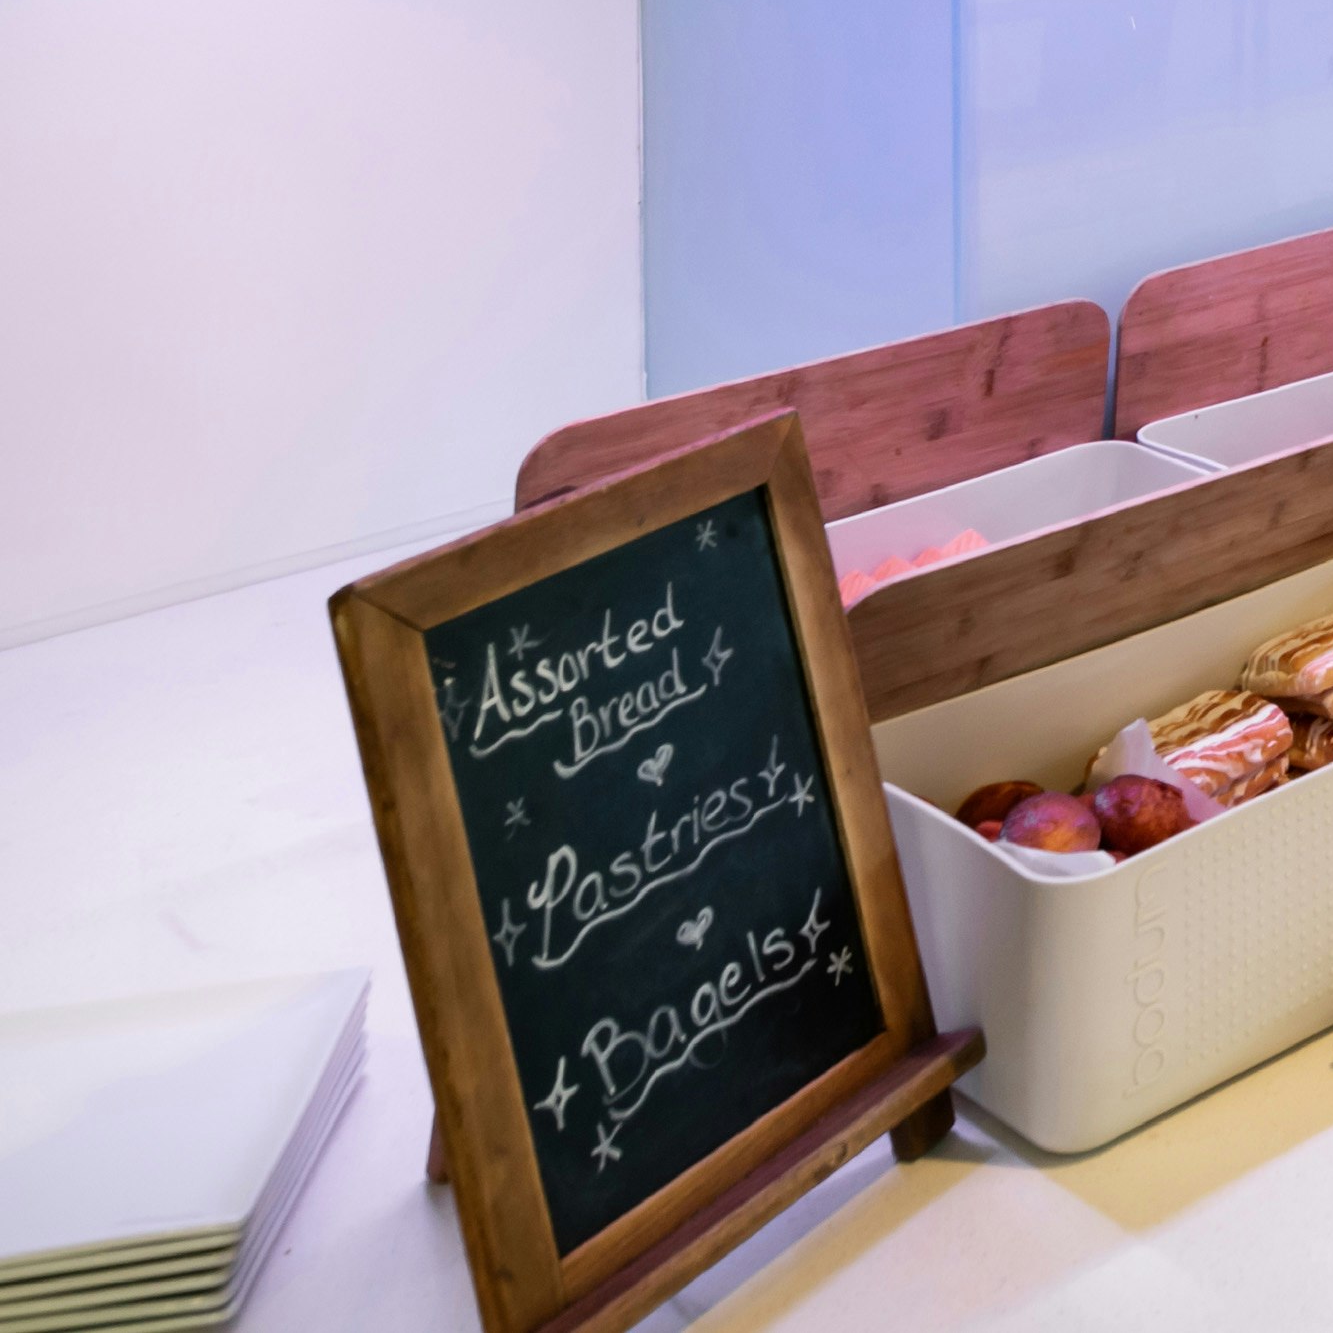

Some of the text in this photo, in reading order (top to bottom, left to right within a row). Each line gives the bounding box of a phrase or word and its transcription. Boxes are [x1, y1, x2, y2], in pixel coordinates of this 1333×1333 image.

[472, 581, 684, 740] Assorted
[566, 649, 688, 760] Bread
[527, 783, 756, 965] Pastries
[580, 923, 796, 1099] Bagels
